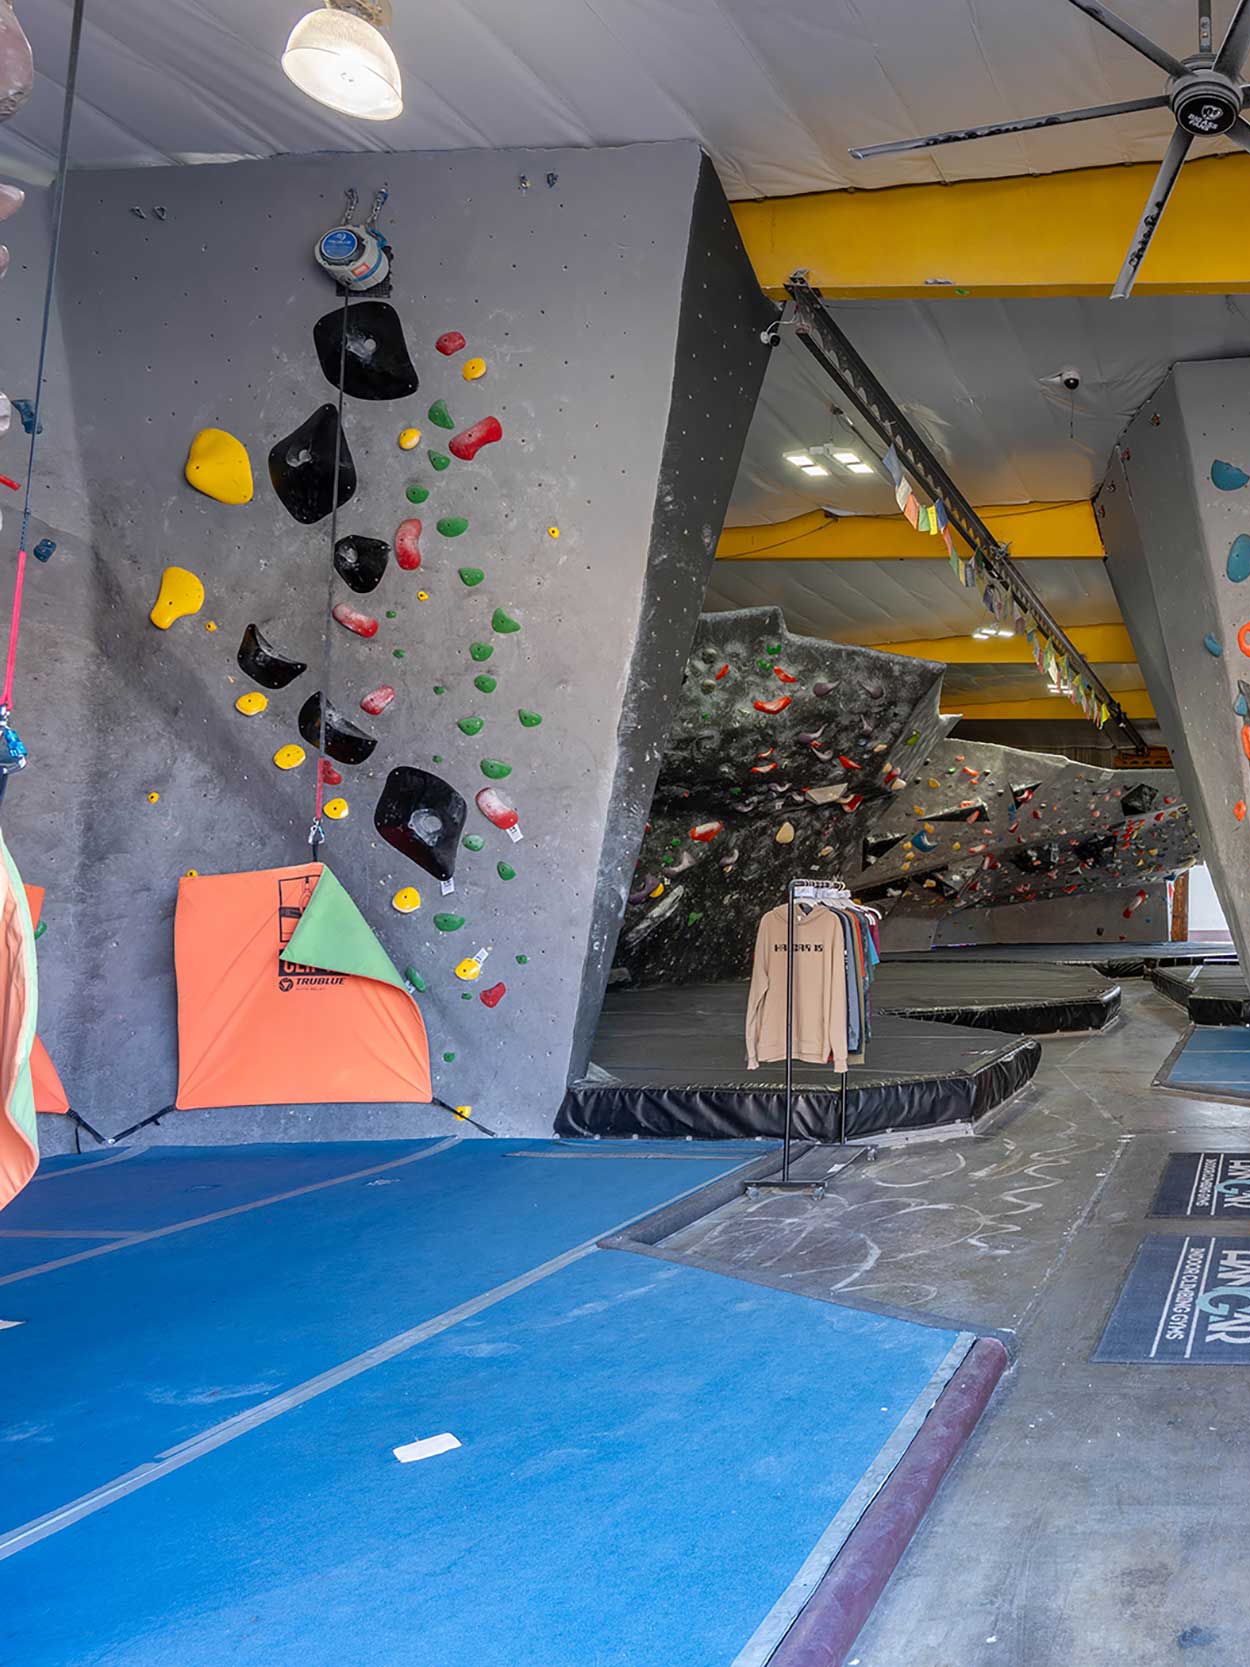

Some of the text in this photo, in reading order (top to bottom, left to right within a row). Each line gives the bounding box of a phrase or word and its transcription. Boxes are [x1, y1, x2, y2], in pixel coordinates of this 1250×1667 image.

[296, 977, 345, 985] TRUBLUE
[1165, 1247, 1206, 1340] INDOOR CLIMBING GYMS
